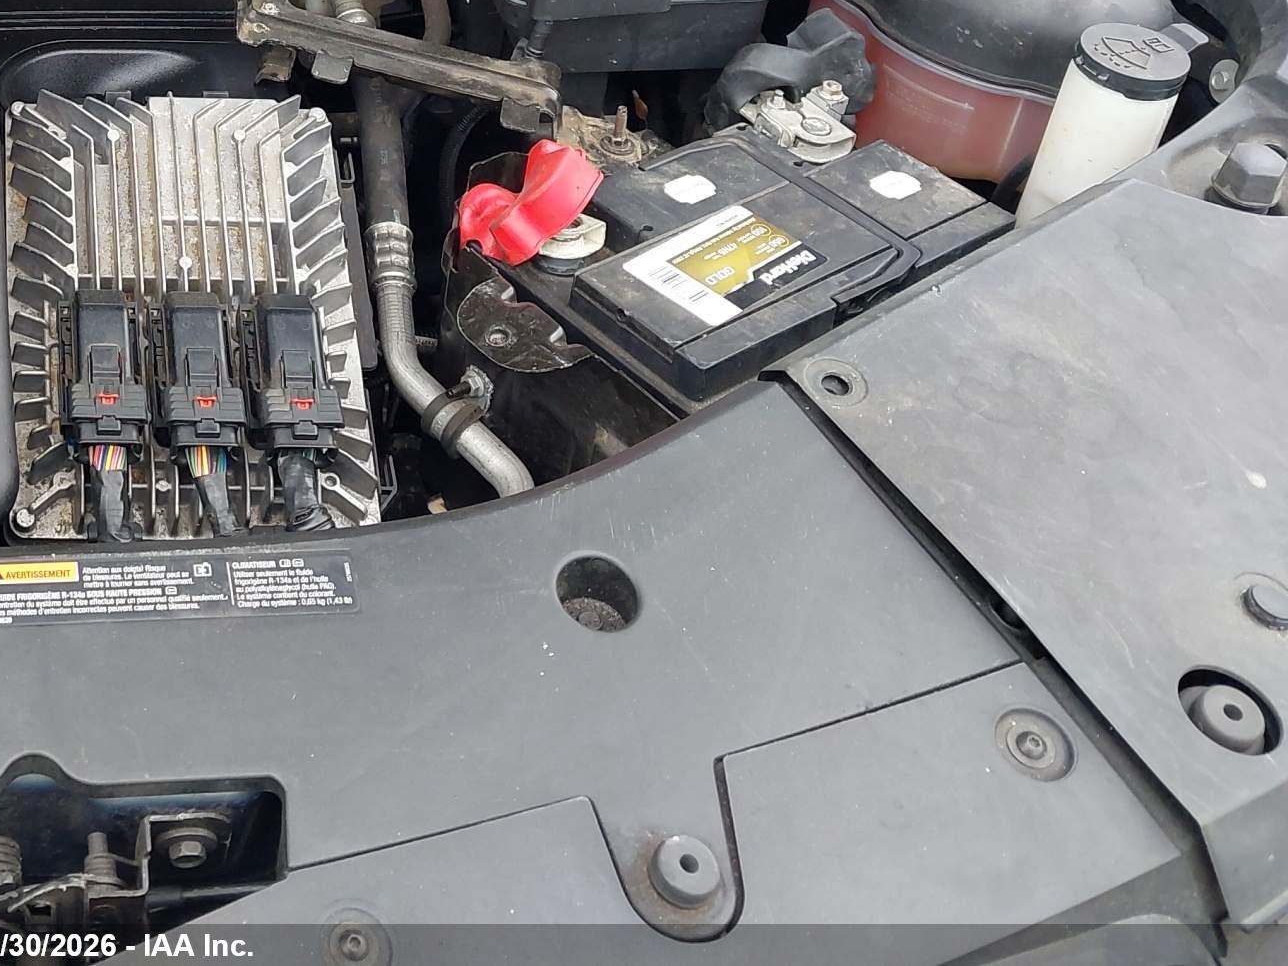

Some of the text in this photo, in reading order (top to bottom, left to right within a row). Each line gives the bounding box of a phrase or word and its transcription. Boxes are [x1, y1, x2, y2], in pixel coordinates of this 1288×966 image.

[705, 266, 735, 285] GOLD
[759, 250, 816, 285] DieHard
[6, 570, 71, 579] AVERTISSEMENT
